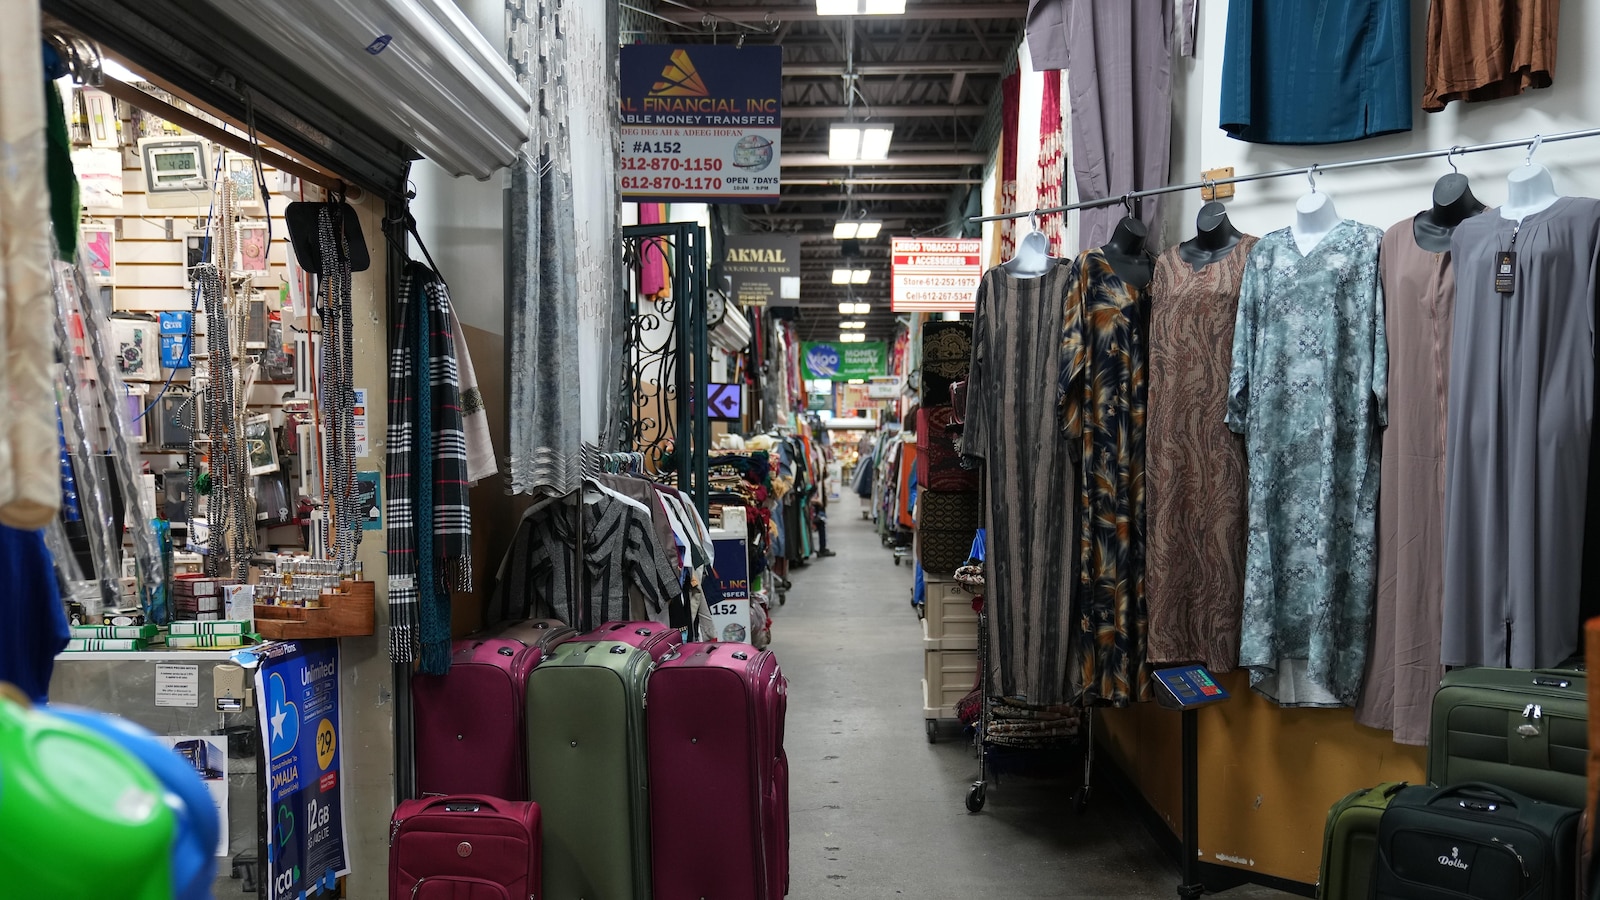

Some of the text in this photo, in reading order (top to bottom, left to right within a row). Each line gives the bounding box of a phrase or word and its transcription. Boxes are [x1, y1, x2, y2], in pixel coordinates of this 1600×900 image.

[643, 98, 741, 114] FINANCIAL
[746, 99, 777, 114] INC
[655, 115, 702, 125] MONEY
[705, 115, 775, 125] TRANSFER
[641, 129, 658, 137] DEG
[660, 129, 672, 137] AH
[674, 129, 680, 137] &
[682, 129, 712, 137] ADEEG
[713, 129, 744, 137] HOFAN
[633, 141, 681, 154] #A152
[621, 157, 723, 171] 612-870-1150
[621, 176, 723, 190] 612-870-1170
[752, 177, 779, 185] 7DAYS
[921, 242, 957, 253] TOBACCO
[958, 243, 979, 253] SHOP
[726, 248, 786, 263] AKMAL
[907, 256, 914, 265] &
[903, 277, 976, 287] Store-612-252-1975
[906, 291, 972, 301] Cell-612-267-5347
[844, 349, 878, 358] MONEY
[729, 579, 747, 589] INC
[711, 604, 737, 615] 152
[300, 656, 335, 687] Unlimited
[1438, 855, 1469, 870] Dollar
